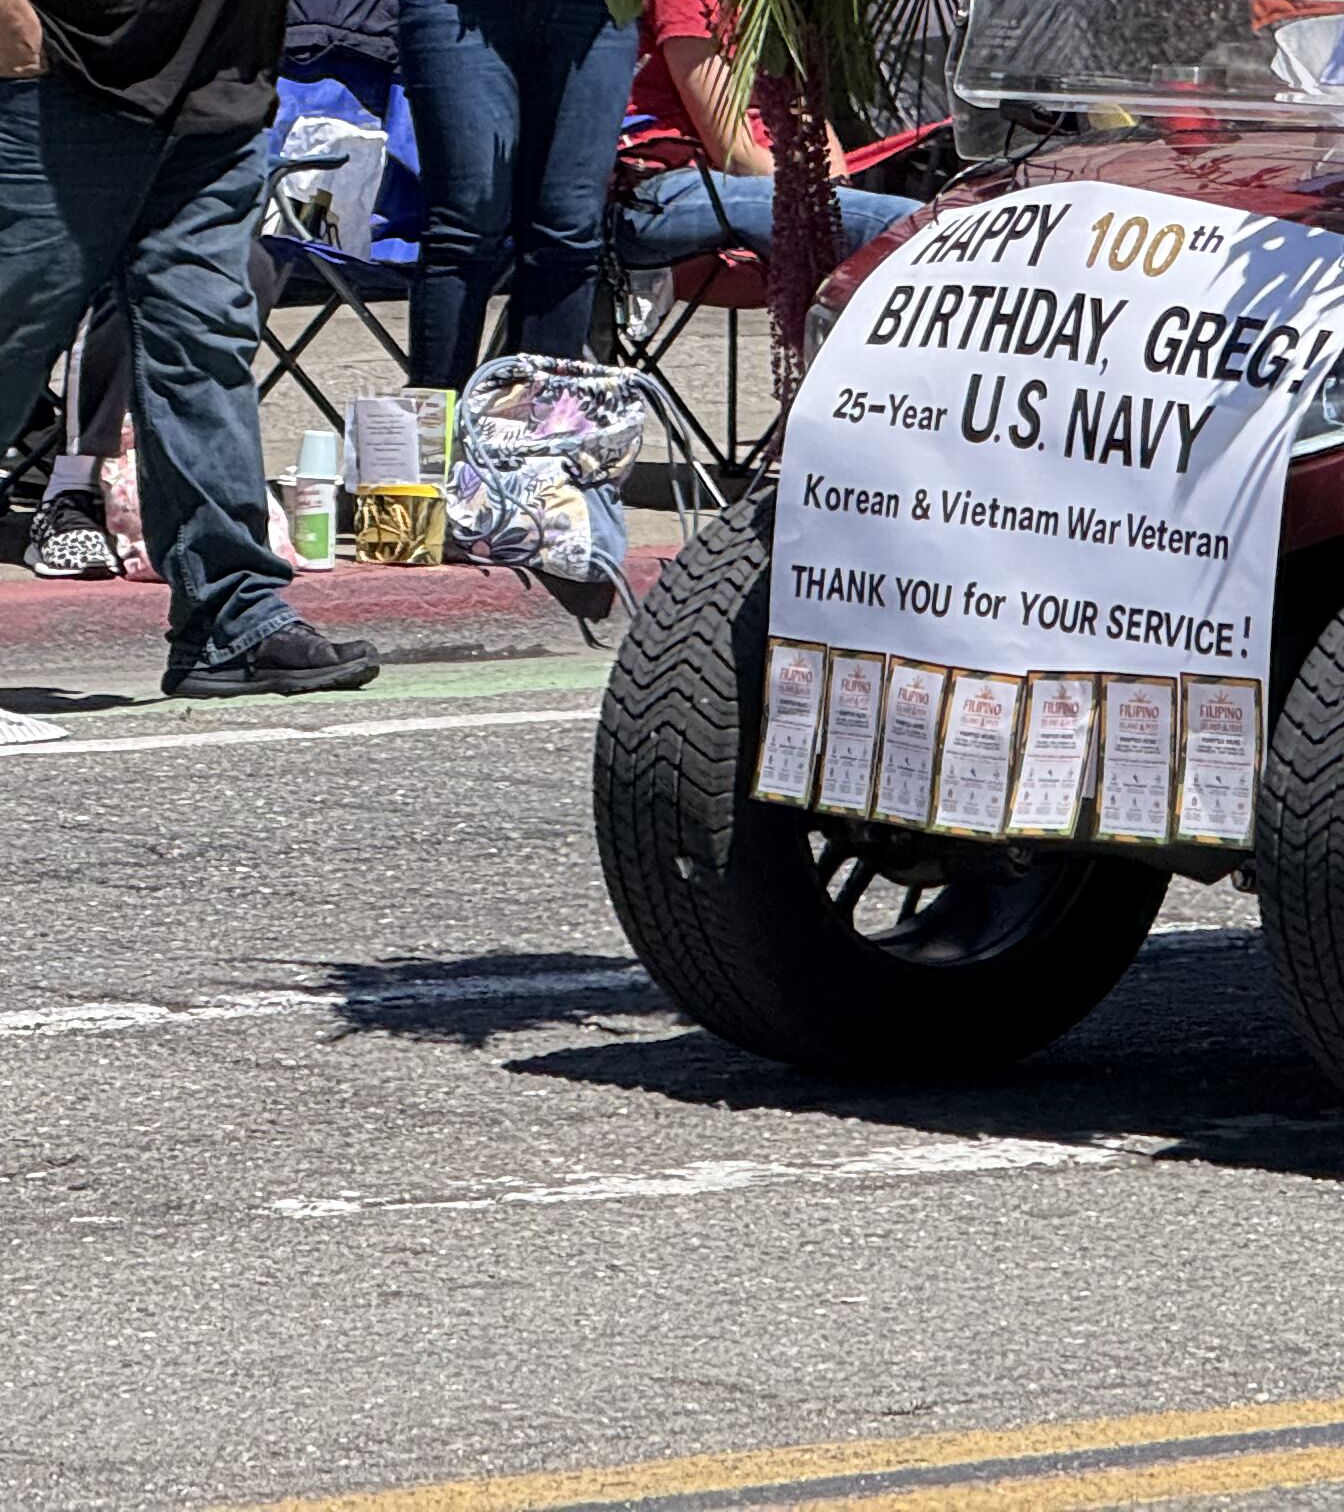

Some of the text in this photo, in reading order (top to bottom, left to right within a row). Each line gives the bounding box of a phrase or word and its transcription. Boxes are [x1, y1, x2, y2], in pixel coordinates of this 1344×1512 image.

[910, 202, 1225, 278] HAPPY 100th
[866, 284, 1335, 394] BIRTHDAY, GREG!
[831, 372, 1217, 475] 25-Year U.S. NAVY
[802, 473, 1230, 561] Korean & Vietnam War Veteran
[790, 563, 887, 608] THANK
[894, 575, 954, 619] YOU
[961, 580, 1008, 621] for
[1019, 590, 1101, 637] YOUR
[1119, 703, 1160, 720] FILIPINO
[1199, 703, 1244, 721] FILIPINO
